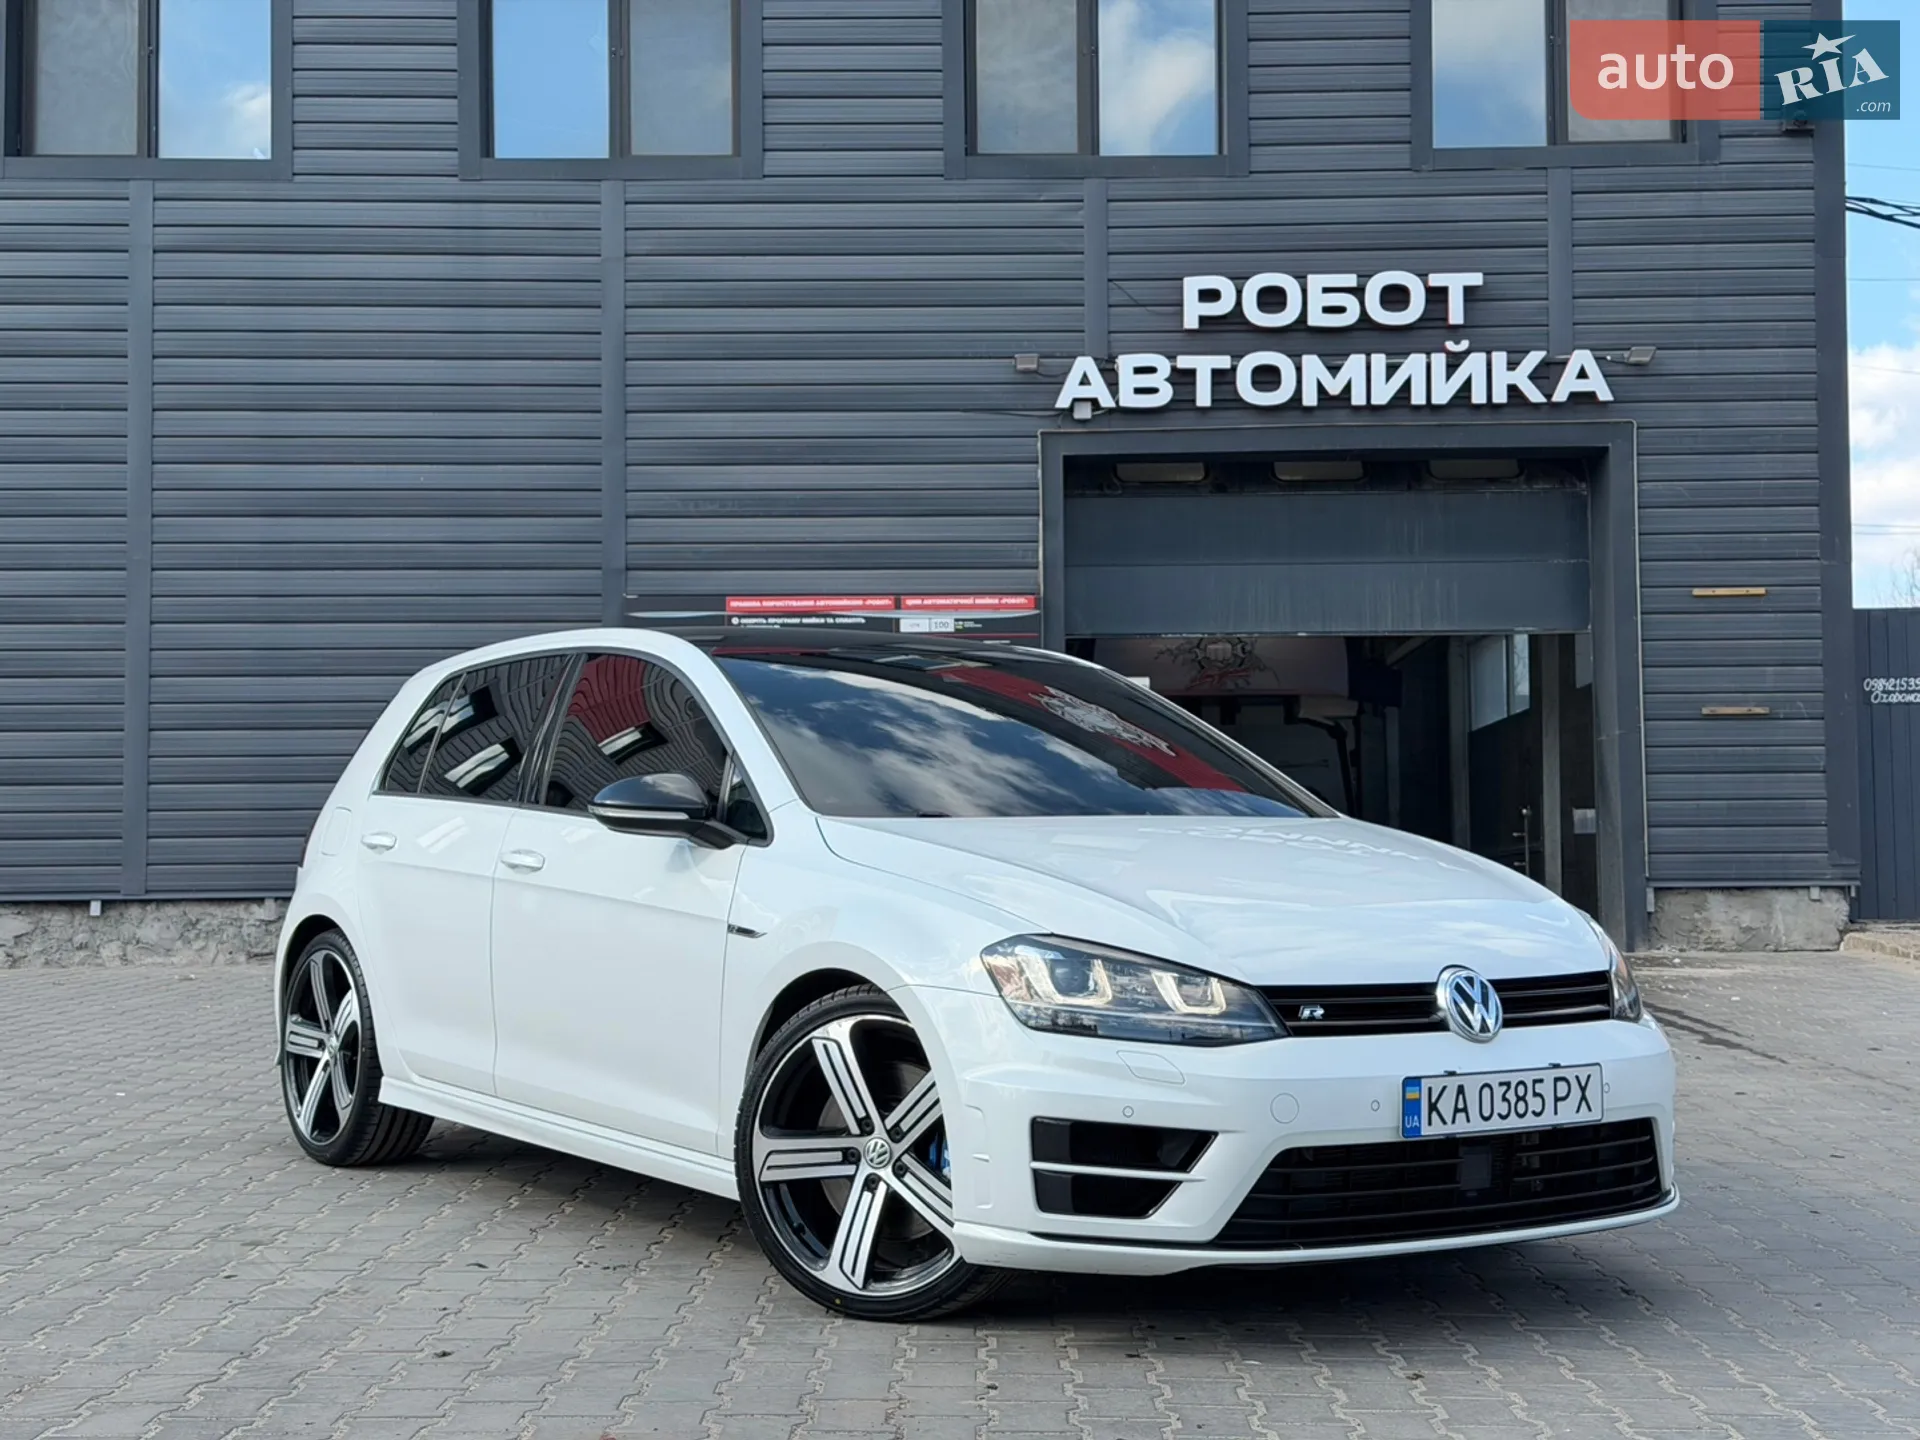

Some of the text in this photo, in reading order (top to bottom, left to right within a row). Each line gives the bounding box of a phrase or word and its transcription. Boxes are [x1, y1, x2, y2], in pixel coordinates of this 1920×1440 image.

[1182, 270, 1484, 331] РОБОТ
[1054, 338, 1615, 410] АВТОМИЙКА
[1404, 1114, 1420, 1129] UA
